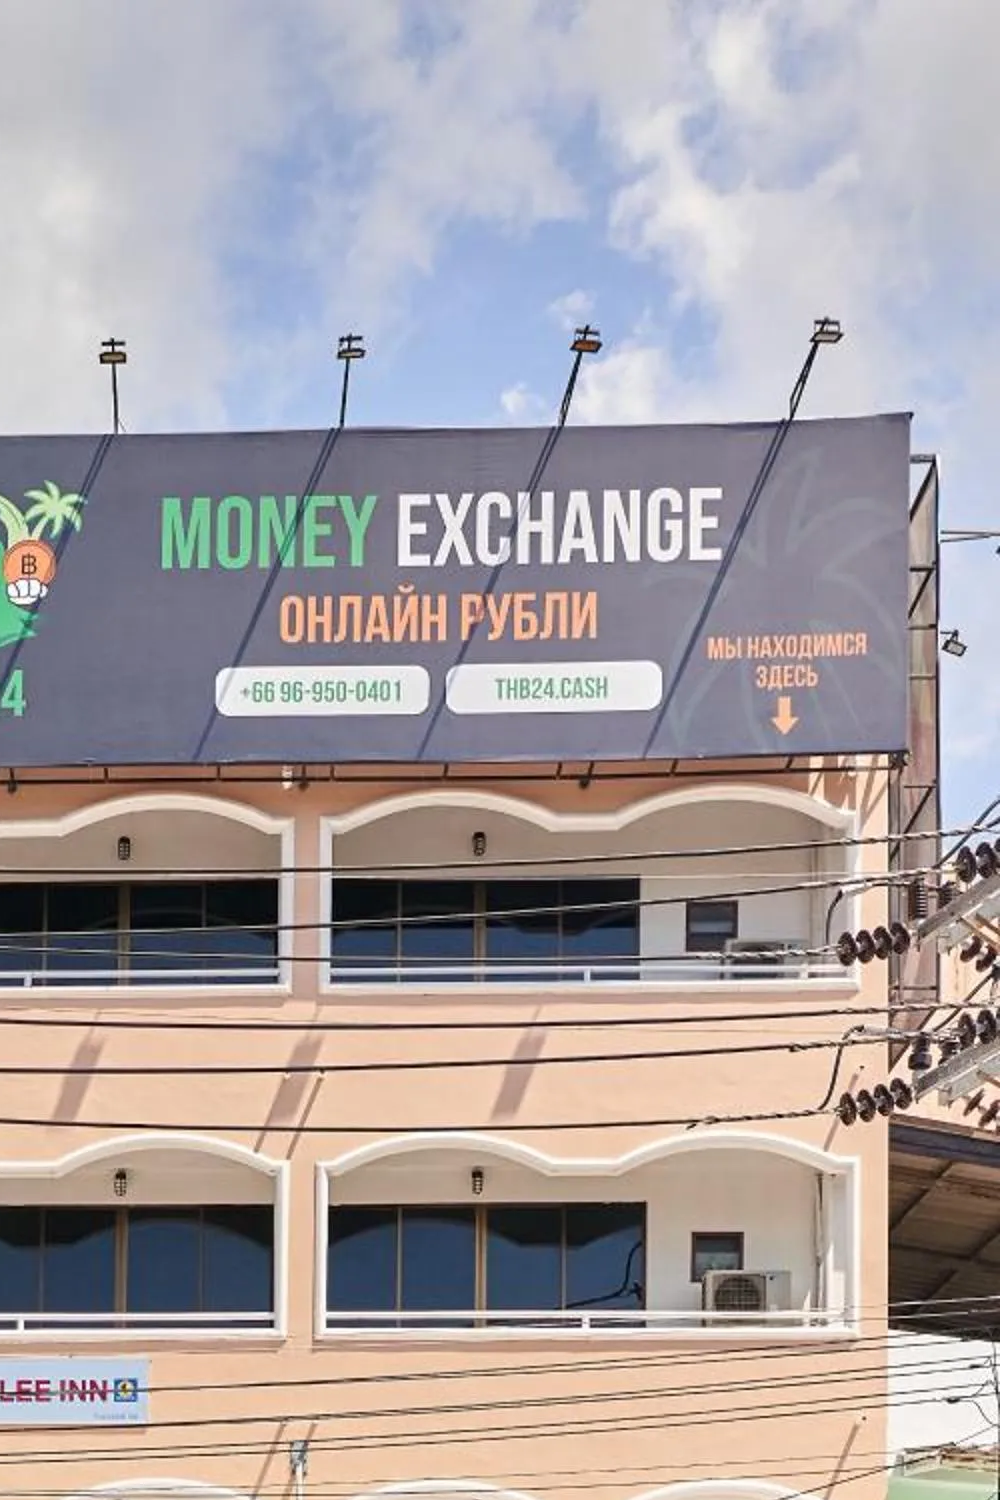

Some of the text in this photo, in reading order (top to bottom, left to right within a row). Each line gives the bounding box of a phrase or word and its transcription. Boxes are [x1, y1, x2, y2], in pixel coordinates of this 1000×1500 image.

[160, 486, 724, 569] MONEY EXCHANGE
[279, 582, 598, 644] ОНЛАЙН РУБЛИ
[707, 632, 868, 661] МЫ НАХОДИМСЯ
[495, 676, 609, 701] THB24.CASH
[756, 664, 819, 691] ЗДЕСЬ
[58, 1379, 109, 1402] INN
